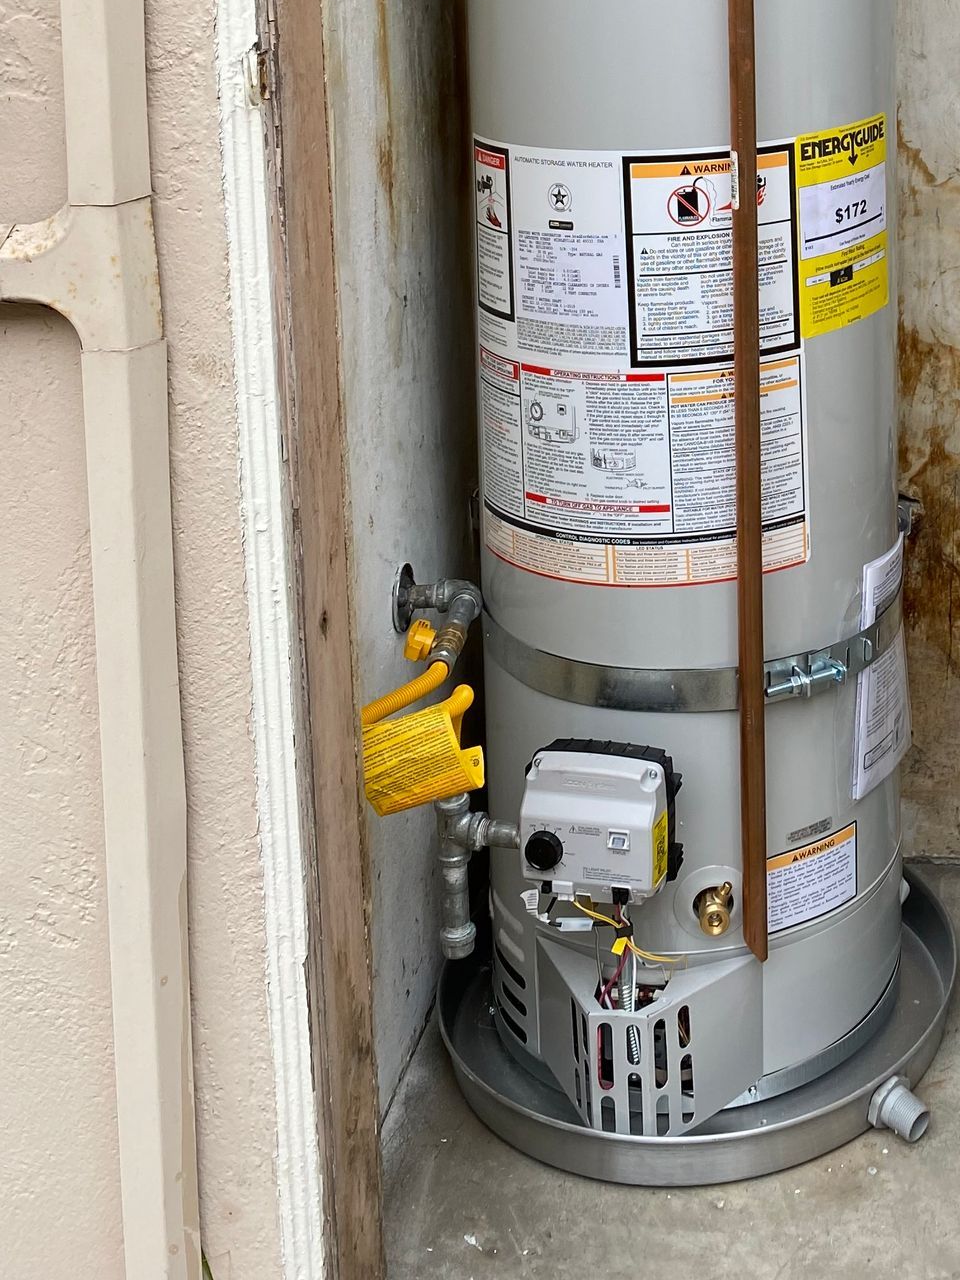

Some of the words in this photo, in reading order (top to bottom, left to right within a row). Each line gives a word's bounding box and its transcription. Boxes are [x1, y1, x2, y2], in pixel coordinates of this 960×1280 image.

[800, 120, 884, 161] ENERGYGUIDE
[835, 199, 867, 225] $172
[797, 839, 836, 860] WARNING
